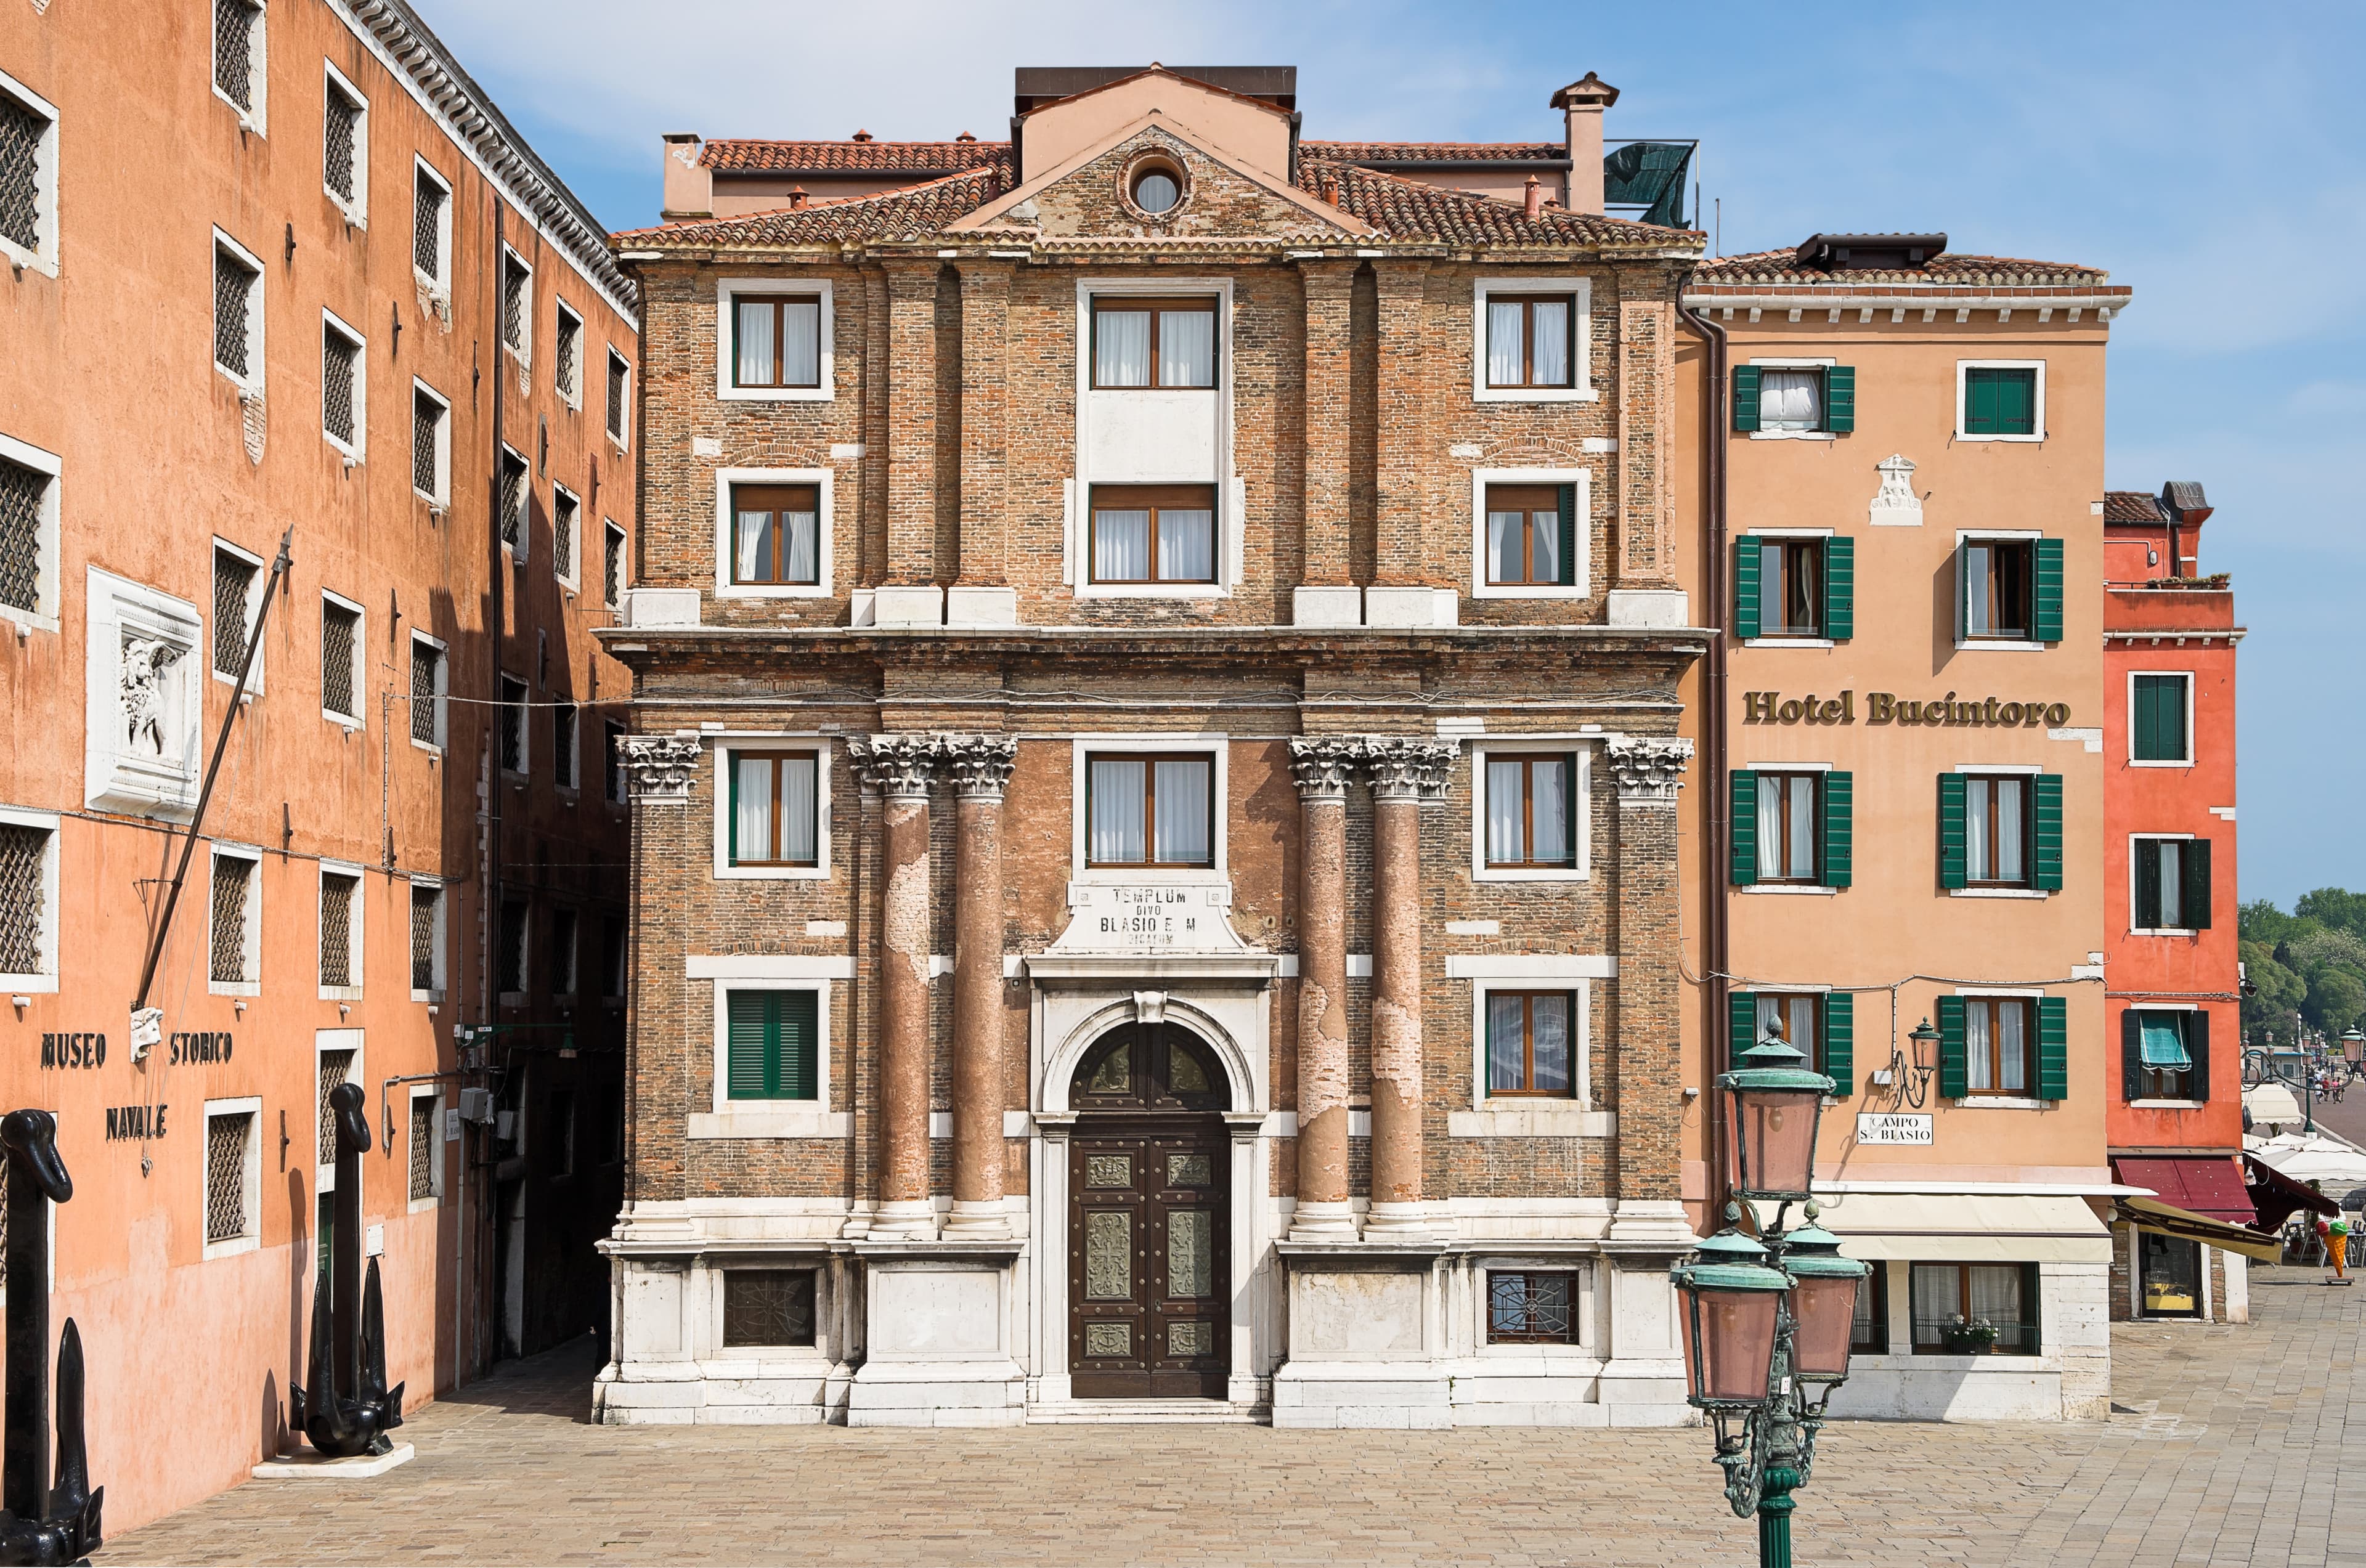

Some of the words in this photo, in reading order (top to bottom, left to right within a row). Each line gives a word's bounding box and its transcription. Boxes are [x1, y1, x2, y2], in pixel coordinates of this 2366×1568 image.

[1744, 690, 1856, 721] Hotel
[1868, 691, 2071, 724] Bucintoro
[1113, 888, 1185, 903] TEMPLUM
[1137, 905, 1161, 916] DIVO
[1101, 917, 1156, 932] BLASIO
[41, 1033, 106, 1067] MUSEO
[170, 1032, 232, 1065] STORICO
[106, 1105, 168, 1143] NAVALE
[1872, 1118, 1918, 1127] CAMPO
[1860, 1130, 1873, 1139] S.
